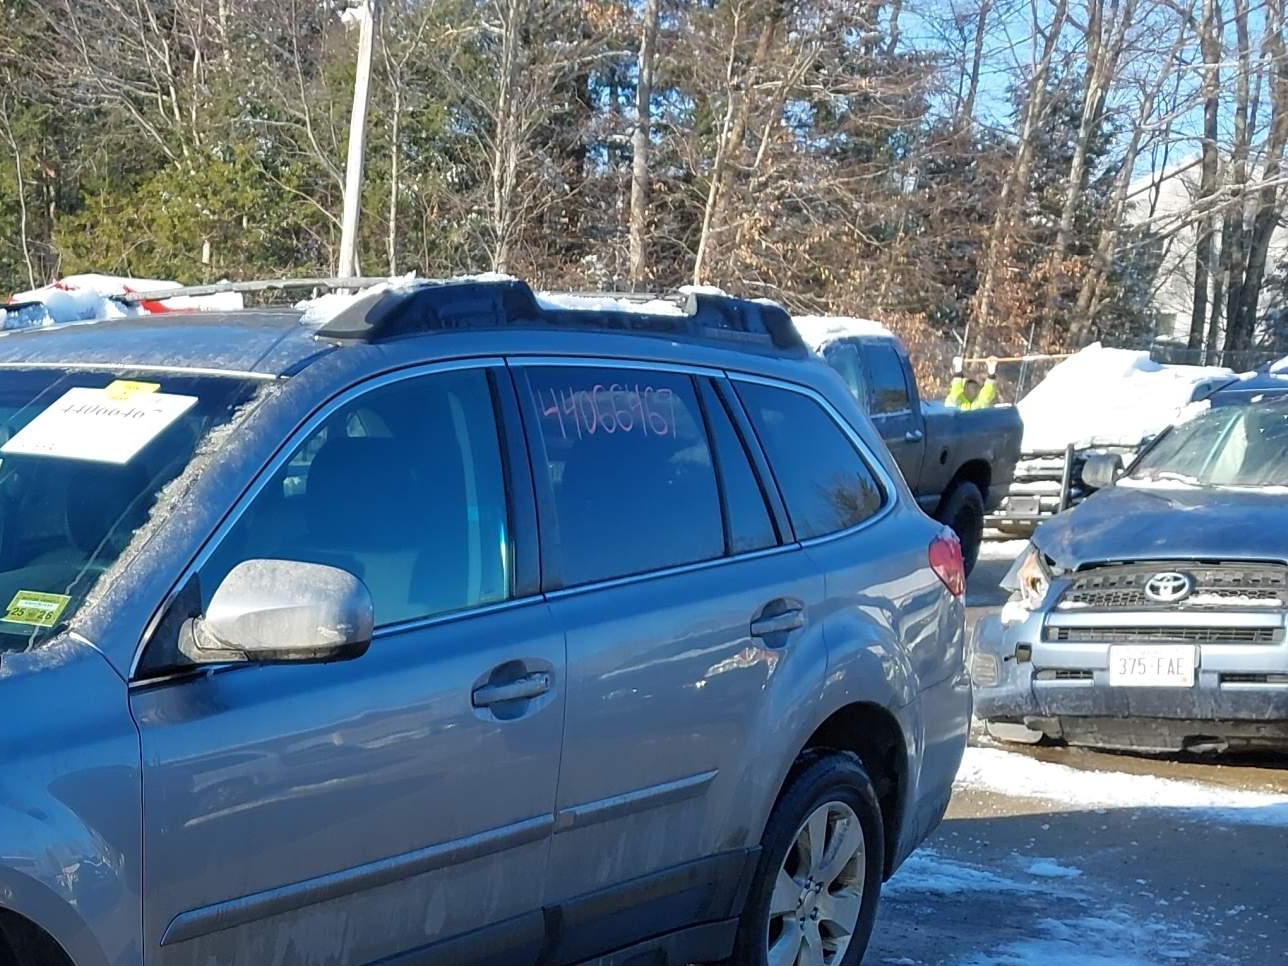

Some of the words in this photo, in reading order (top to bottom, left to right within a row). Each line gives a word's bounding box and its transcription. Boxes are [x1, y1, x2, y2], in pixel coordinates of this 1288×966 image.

[538, 384, 676, 440] 44066467
[11, 607, 24, 616] 25
[1119, 657, 1146, 676] 375
